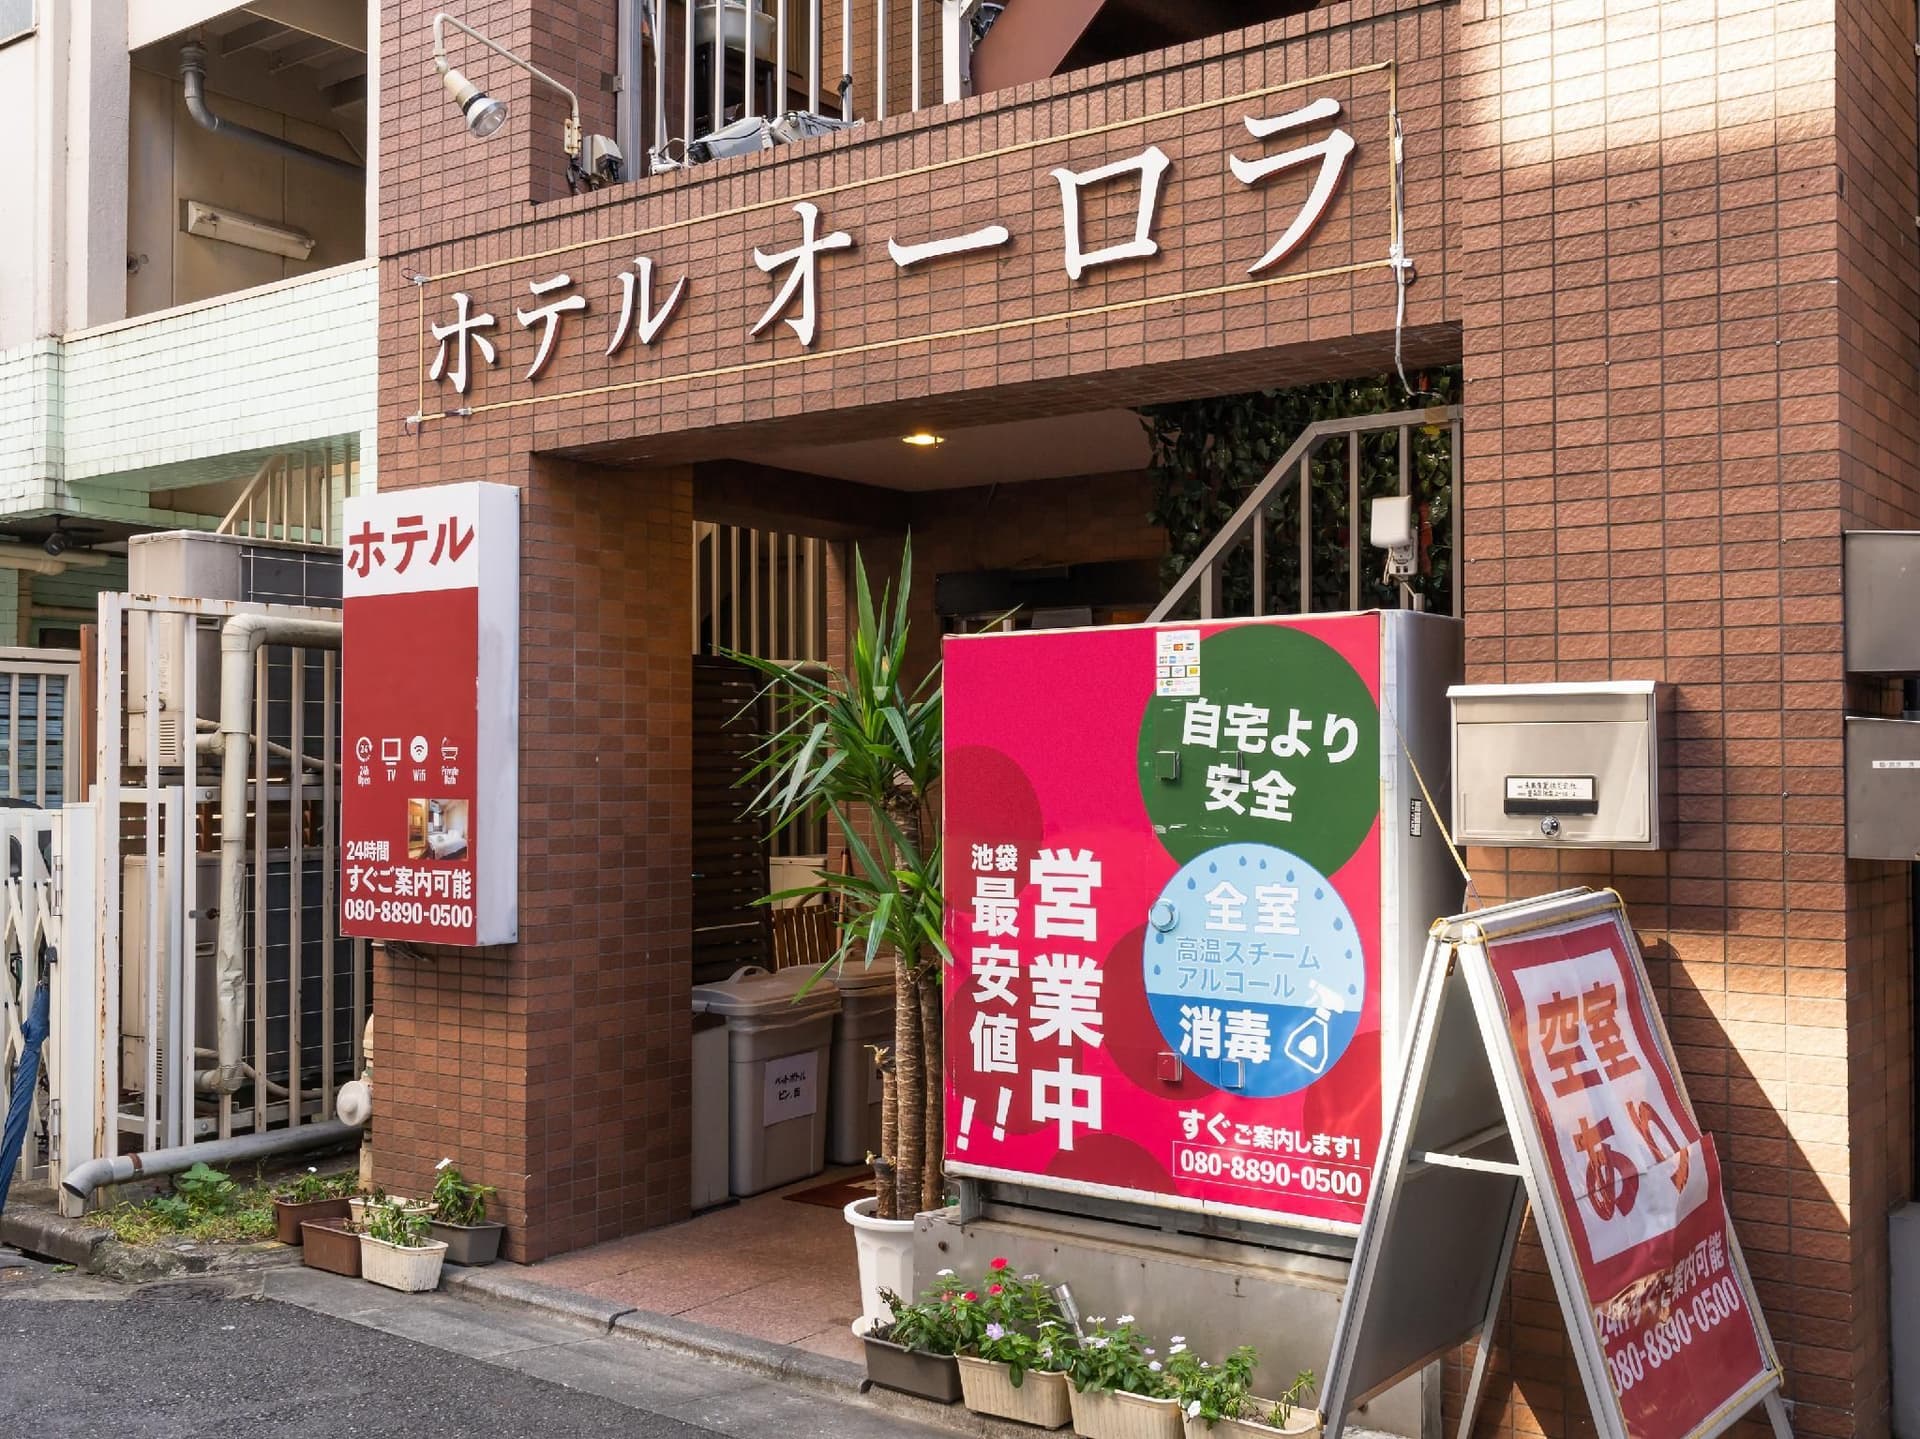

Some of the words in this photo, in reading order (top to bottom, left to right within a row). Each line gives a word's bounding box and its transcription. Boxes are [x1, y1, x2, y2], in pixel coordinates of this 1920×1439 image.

[430, 256, 688, 394] ホテル
[750, 97, 1356, 347] オーロラ
[347, 514, 475, 578] ホテル
[1182, 697, 1358, 763] 自宅より
[387, 769, 396, 782] TV
[412, 768, 427, 782] Wifi
[1204, 763, 1297, 822] 安全
[346, 840, 390, 862] 24時間
[971, 843, 1018, 872] 池袋
[346, 865, 472, 899] すぐご案内可能
[1204, 881, 1301, 936] 全室
[344, 898, 473, 928] 080-8890-0500
[1177, 937, 1320, 970] 高温スチーム
[1028, 848, 1105, 1151] 営業中
[1178, 966, 1296, 998] アルコール
[1178, 1004, 1271, 1064] 消毒
[1537, 981, 1641, 1098] 空室
[1178, 1108, 1361, 1161] すぐご案内します!
[1572, 1101, 1689, 1221] あり
[1180, 1148, 1362, 1197] 080-8890-0500
